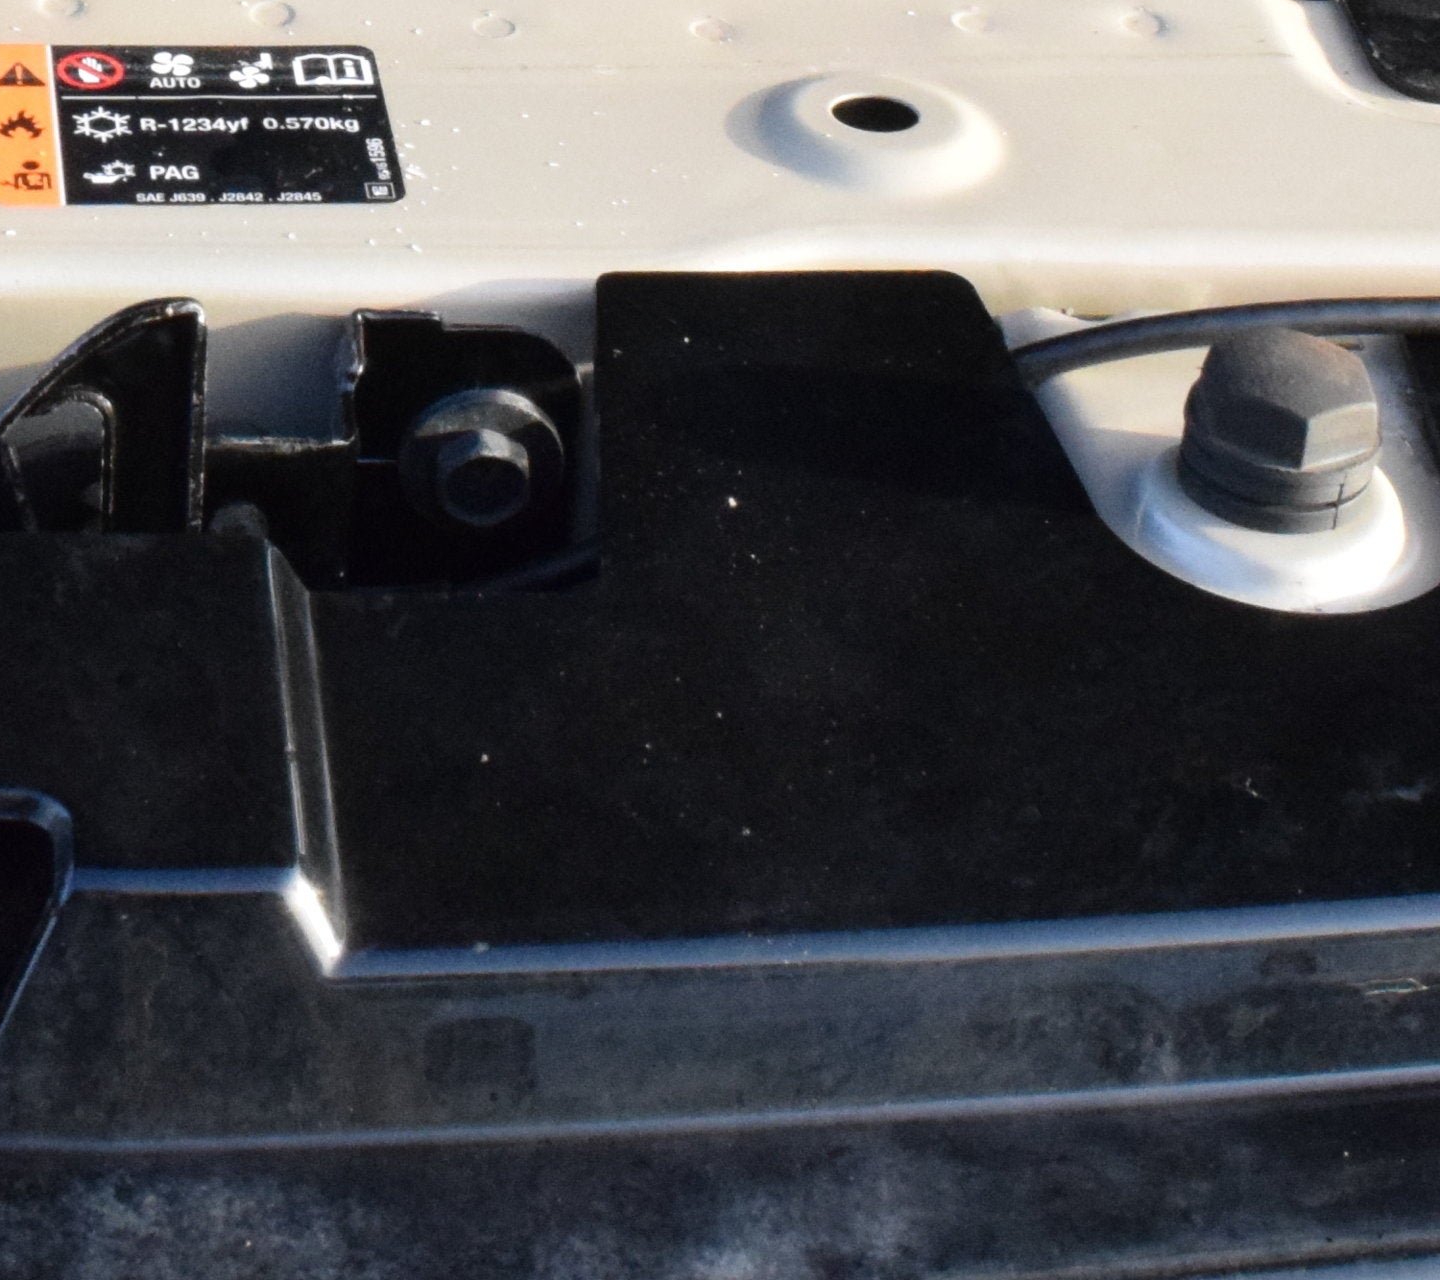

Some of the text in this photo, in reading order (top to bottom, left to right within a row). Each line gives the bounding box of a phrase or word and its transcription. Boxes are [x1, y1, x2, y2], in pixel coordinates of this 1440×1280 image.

[149, 77, 201, 89] AUTO
[139, 117, 361, 134] R-1234yf 0.570kg
[149, 164, 200, 181] PAG
[135, 192, 165, 202] SAE
[169, 192, 206, 202] J639
